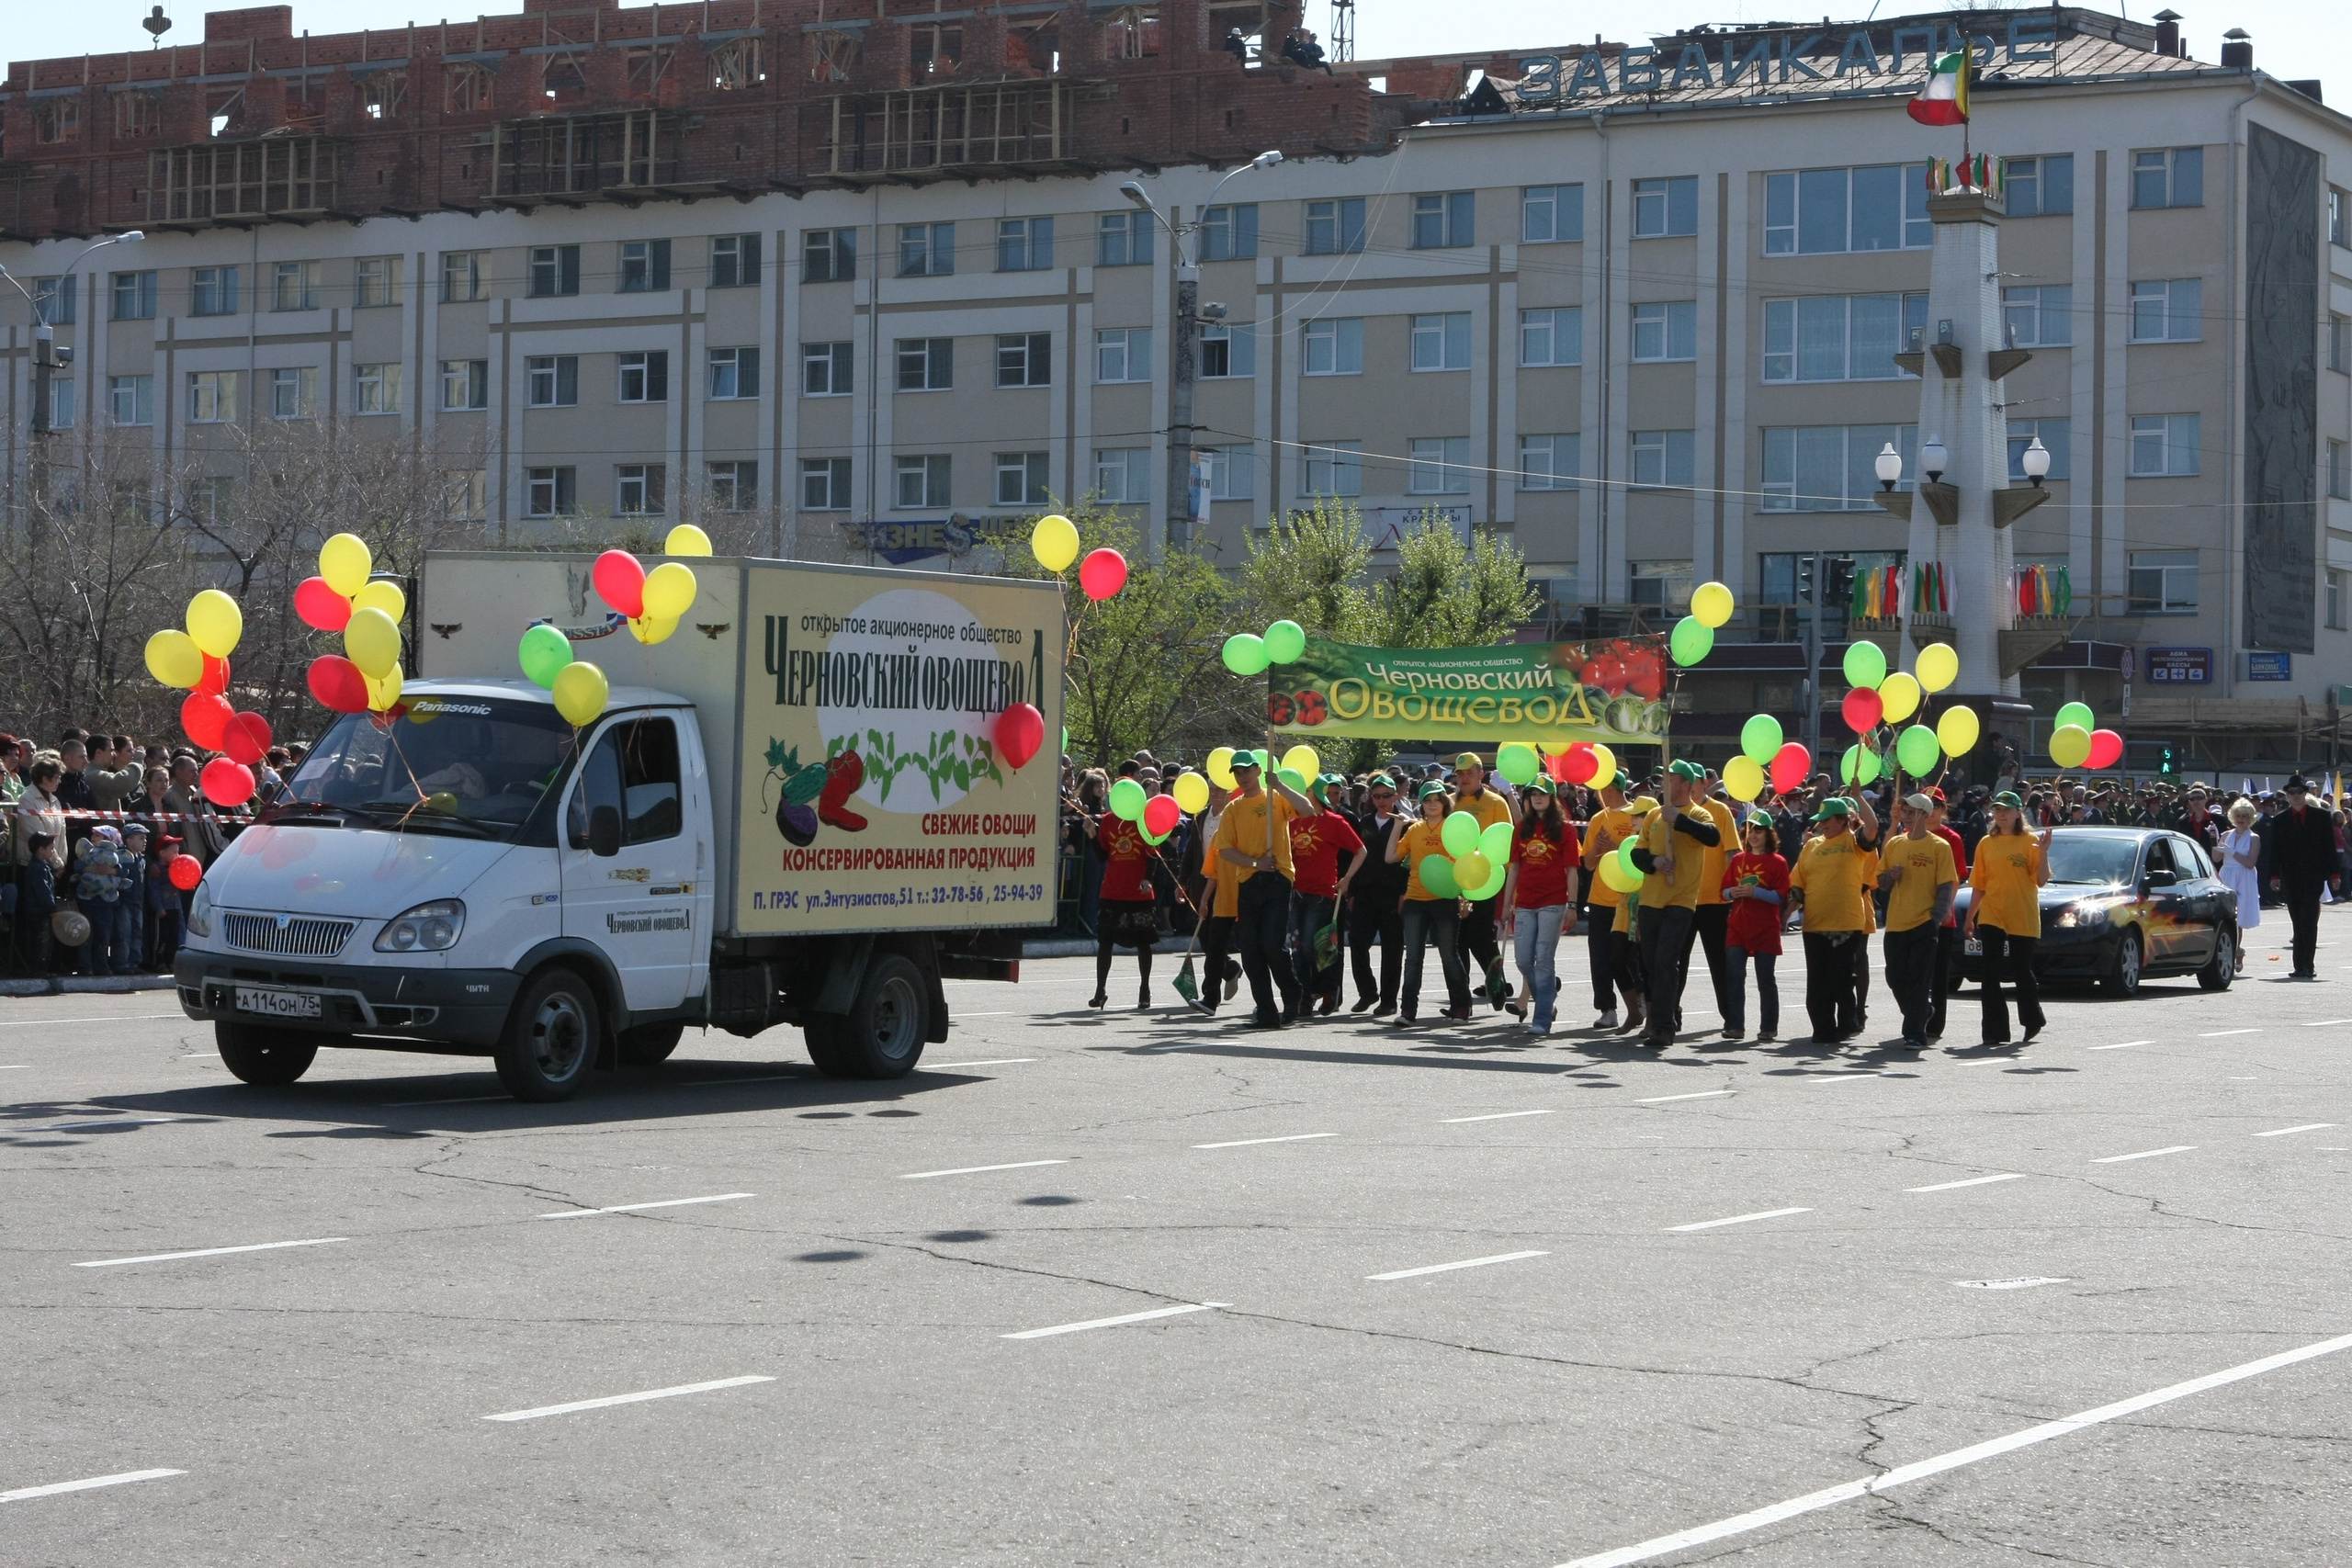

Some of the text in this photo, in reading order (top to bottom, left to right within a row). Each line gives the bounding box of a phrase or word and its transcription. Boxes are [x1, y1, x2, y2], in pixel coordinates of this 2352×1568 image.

[801, 614, 1023, 646] открытое акционерное общество
[1365, 662, 1554, 694] Черновский
[413, 701, 492, 716] Panasonic
[922, 814, 1035, 838] СВЕЖИЕ ОВОЩИ
[782, 847, 1035, 873] КОНСЕРВИРОВАННАЯ ПРОДУКЦИЯ
[770, 890, 799, 909] ГРЭС
[993, 884, 1043, 902] 25-94-39
[300, 996, 315, 1009] 75
